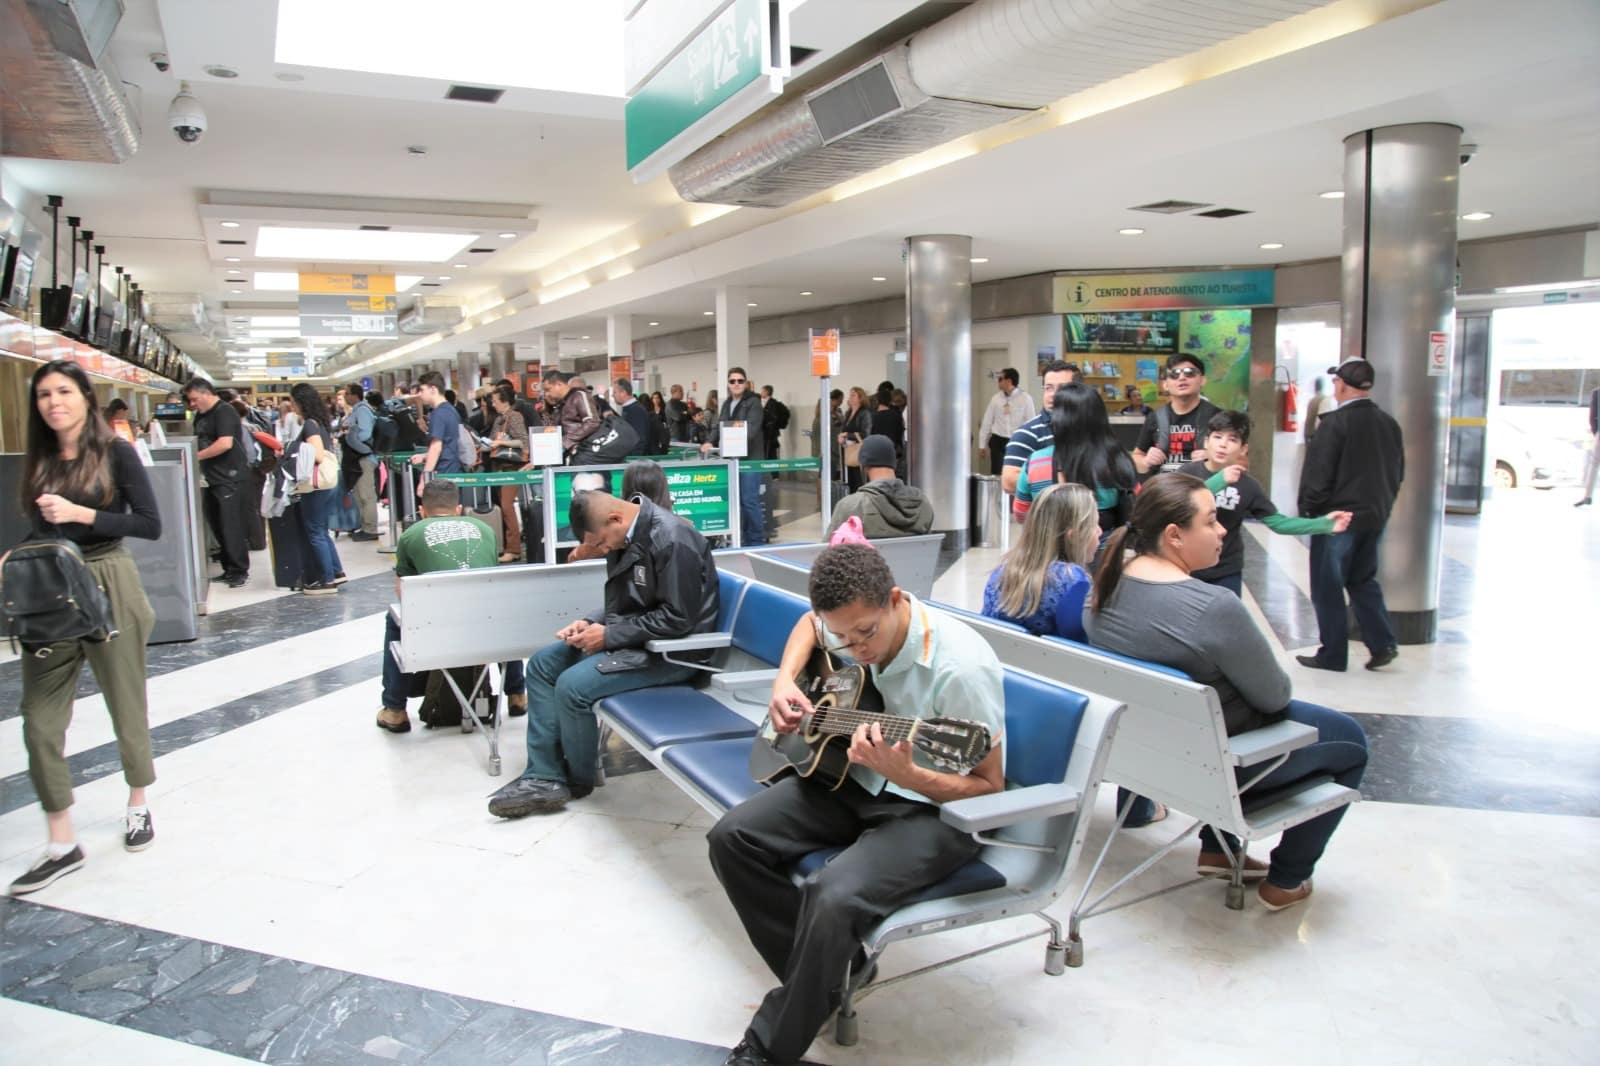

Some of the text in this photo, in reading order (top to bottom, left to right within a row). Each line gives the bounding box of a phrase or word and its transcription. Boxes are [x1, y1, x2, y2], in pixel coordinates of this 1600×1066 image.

[1095, 287, 1128, 297] CENTRO
[1130, 287, 1142, 296] DE
[1143, 284, 1206, 296] ATENDIMENTO
[1207, 284, 1221, 293] AO
[667, 474, 717, 484] aliza Hertz
